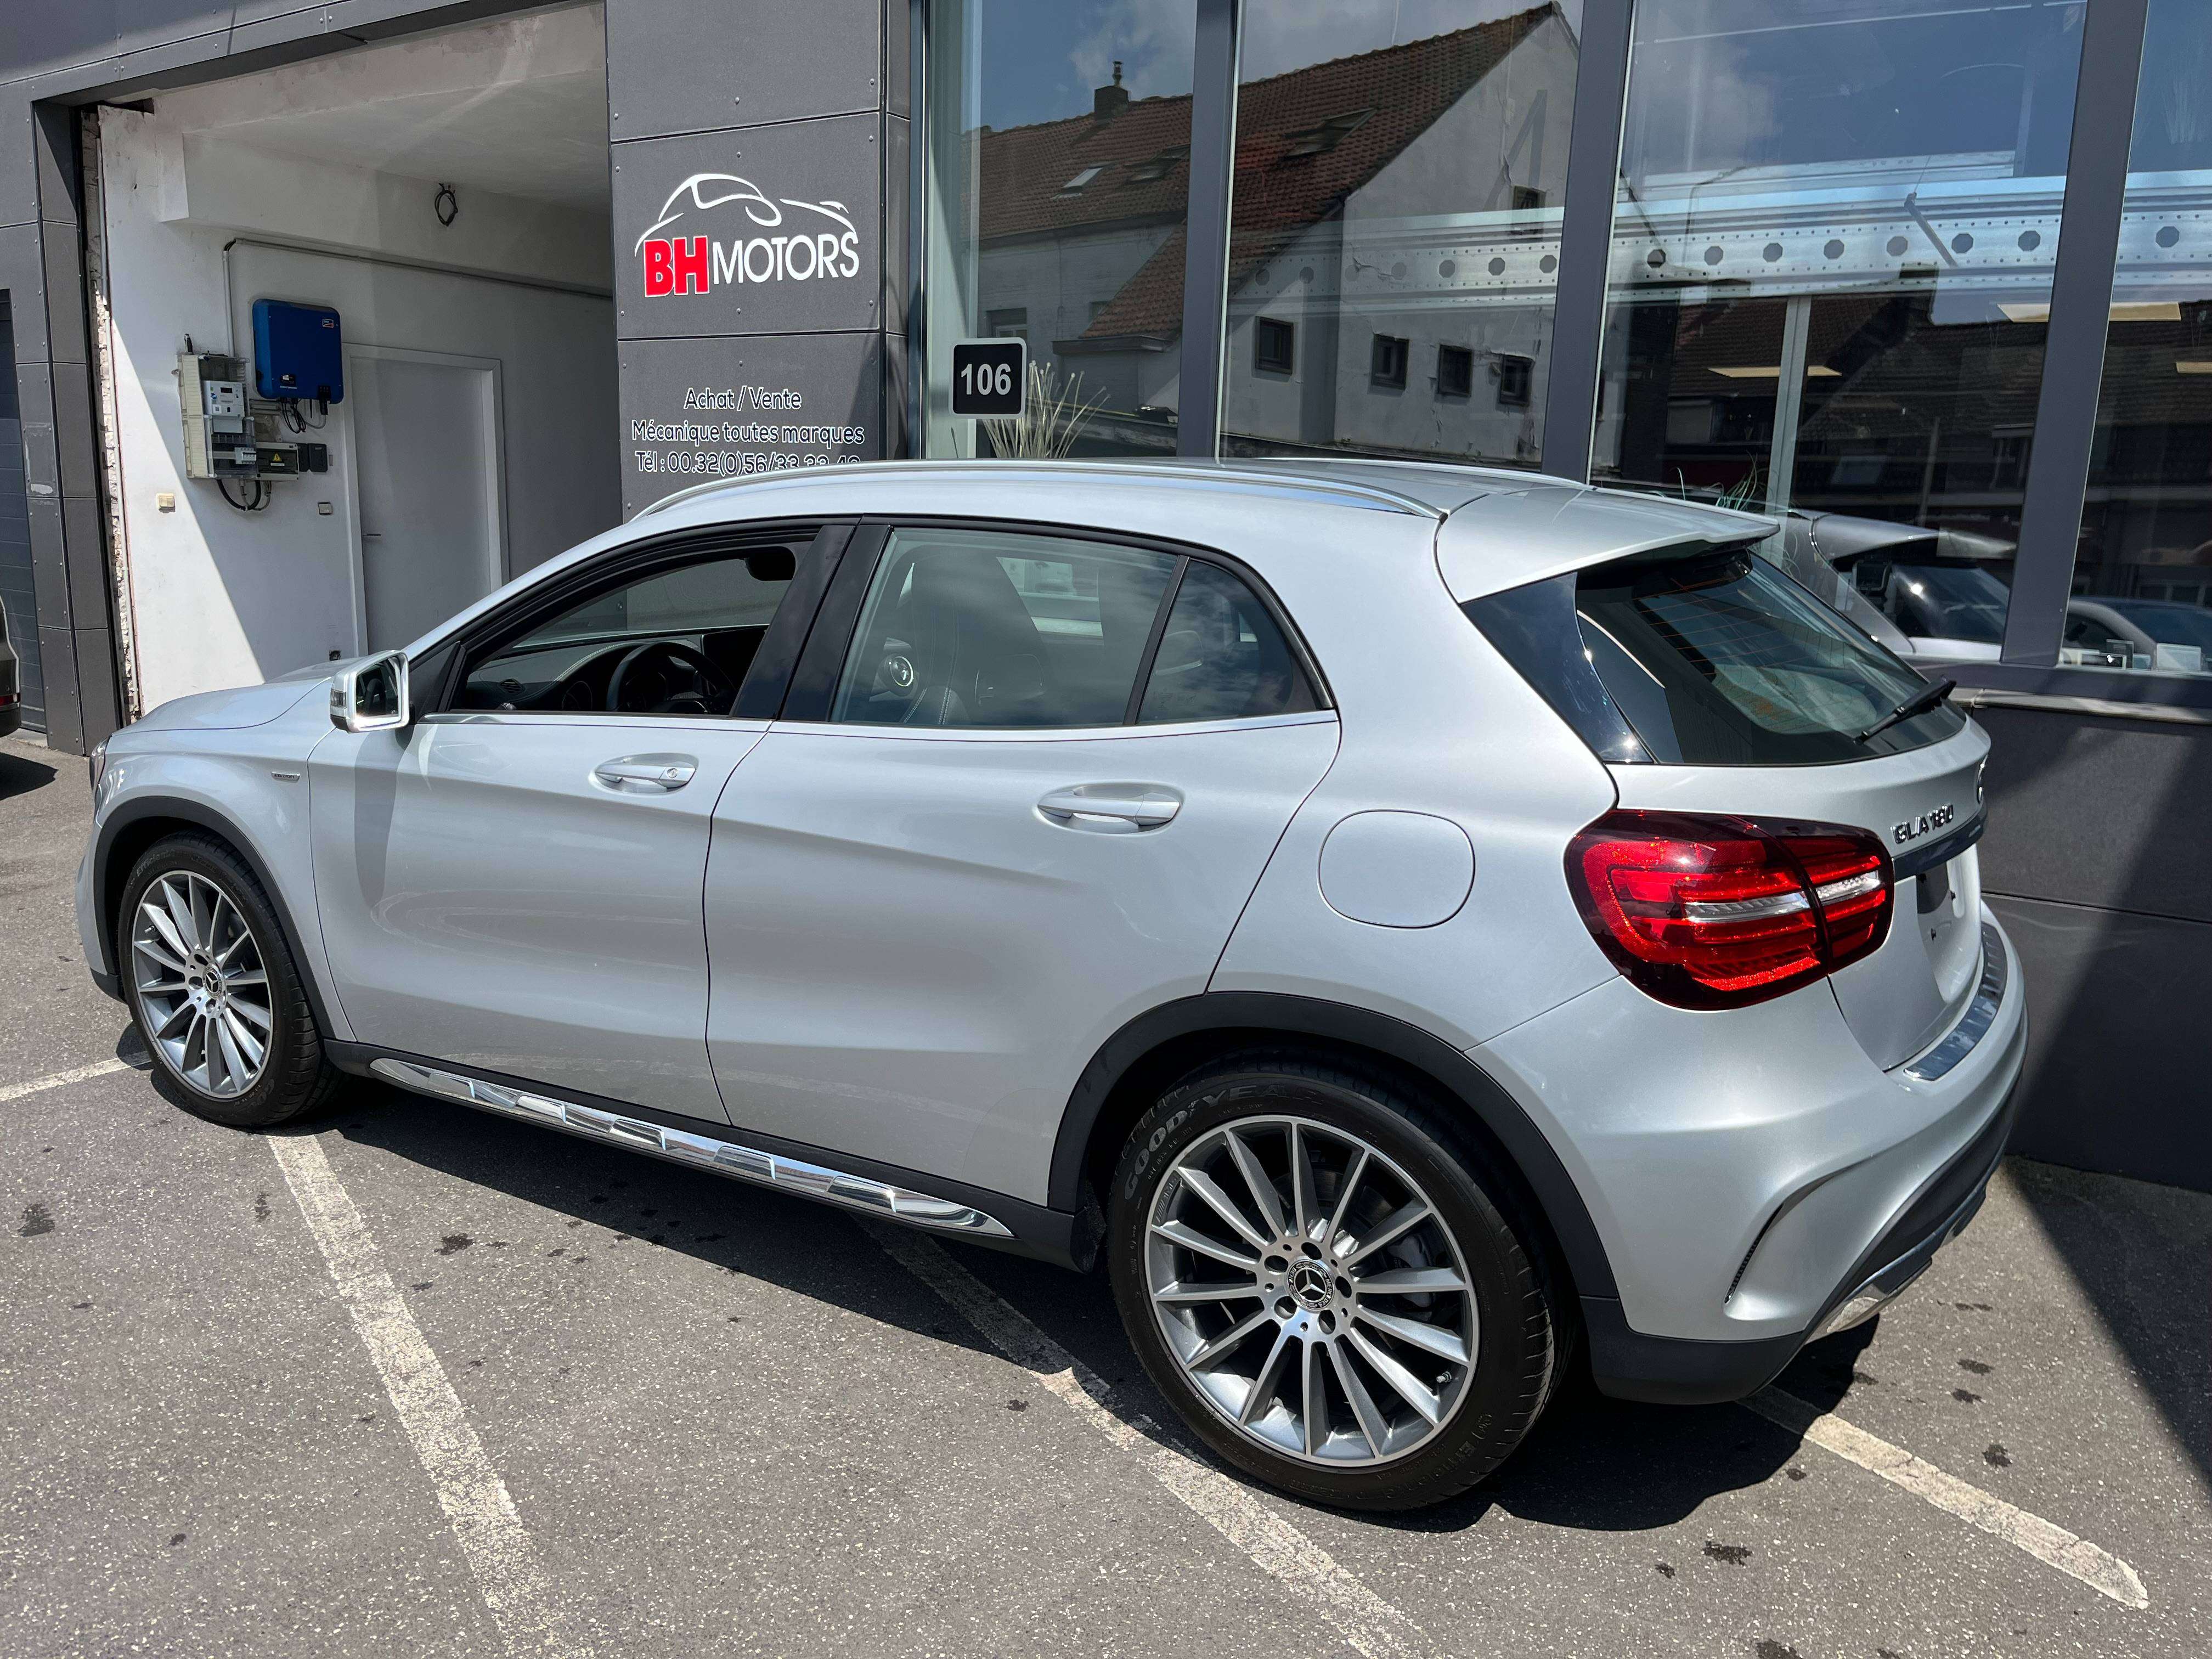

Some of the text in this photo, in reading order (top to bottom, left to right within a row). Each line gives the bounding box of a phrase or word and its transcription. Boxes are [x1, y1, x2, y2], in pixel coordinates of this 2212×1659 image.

[644, 233, 859, 297] BH MOTORS
[961, 363, 1011, 395] 106
[684, 387, 735, 410] Achat
[748, 387, 802, 410] Vente
[632, 420, 865, 449] Mécanique toutes marques
[1890, 804, 1954, 844] GLA 180
